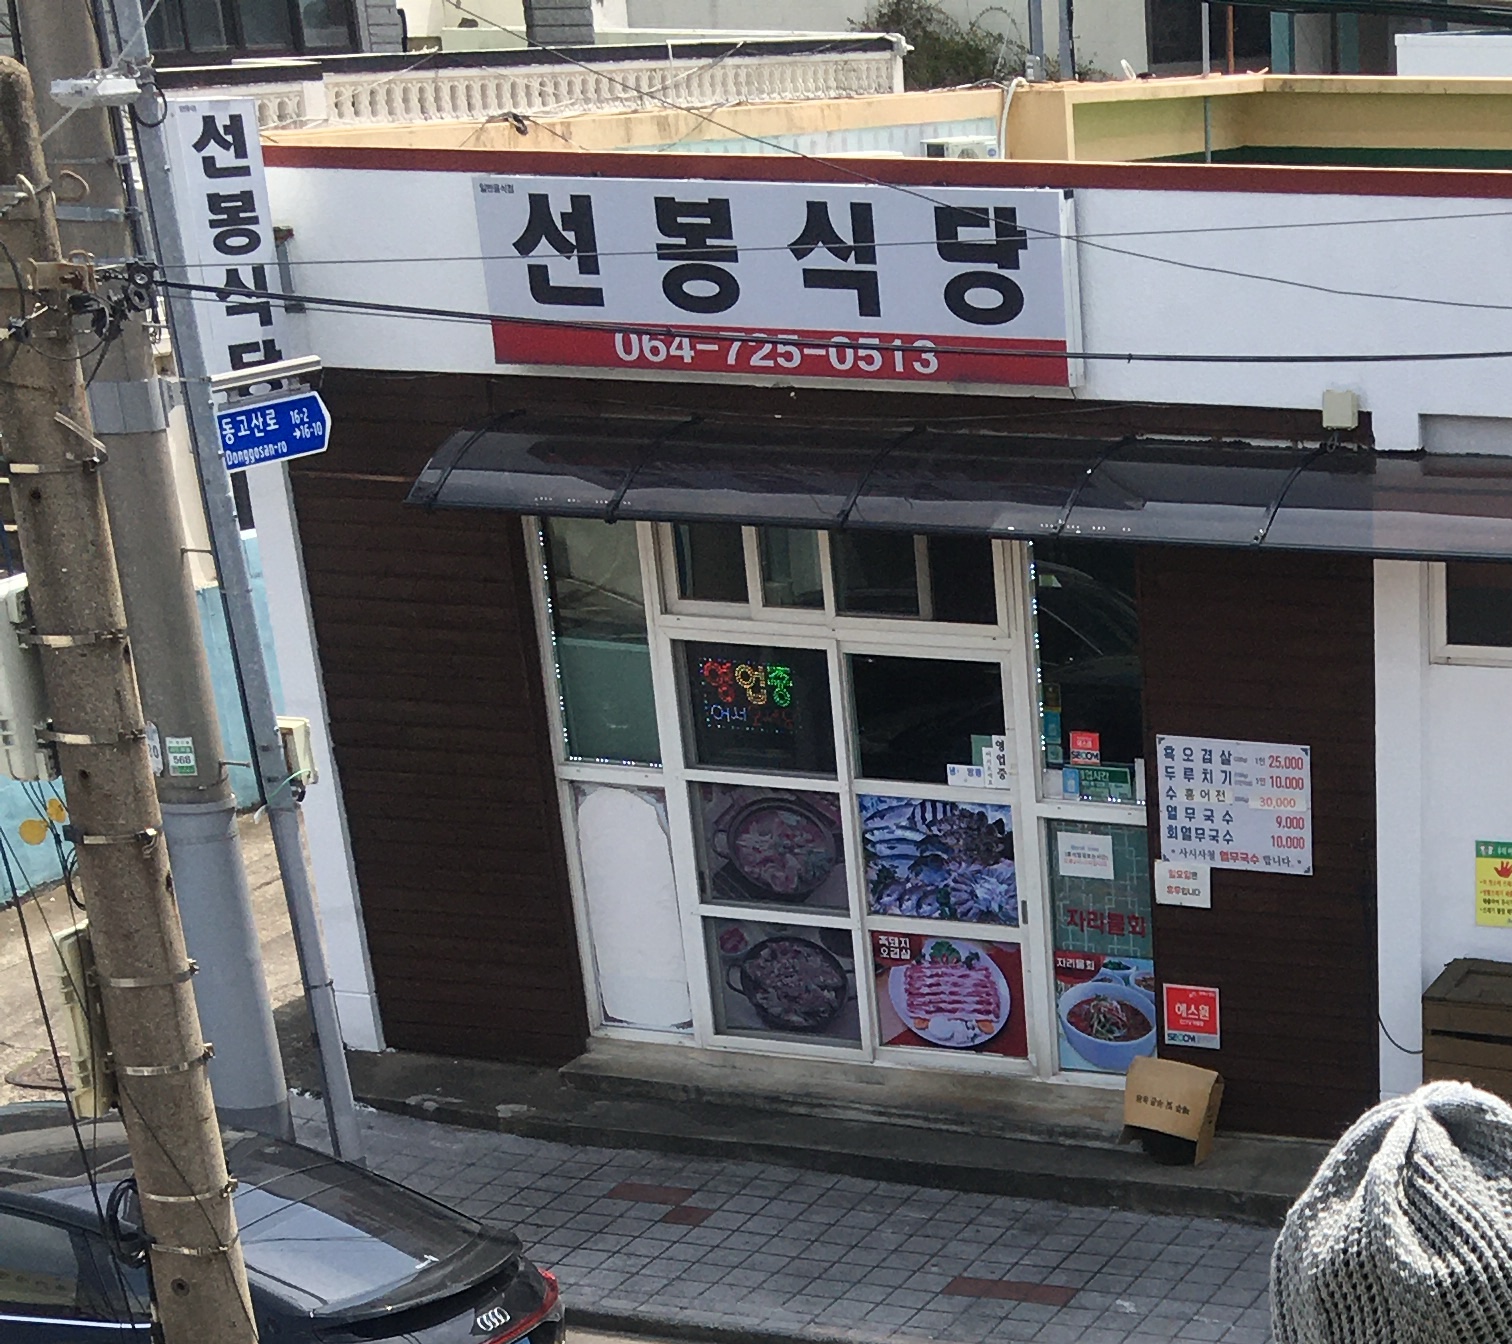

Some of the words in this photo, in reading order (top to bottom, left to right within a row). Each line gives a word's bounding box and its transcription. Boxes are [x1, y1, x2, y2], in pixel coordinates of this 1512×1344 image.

[512, 193, 1027, 326] 선봉식당
[615, 331, 938, 374] 064-725-0513
[290, 408, 309, 424] 16-2
[221, 409, 279, 444] 동고산로
[225, 440, 288, 466] Donggosan-ro
[703, 661, 793, 707] 영업중
[995, 740, 1007, 780] 영업중
[1071, 750, 1099, 760] SECOM
[1260, 797, 1297, 808] 30,000
[1166, 805, 1234, 825] 열무국수
[1167, 824, 1234, 845] 회열무국수
[1219, 850, 1260, 865] 열무국수
[879, 936, 909, 948] 흑돼지
[880, 947, 910, 959] 오겹살
[1175, 1002, 1210, 1020] 에스원
[1167, 1033, 1196, 1043] SECOM
